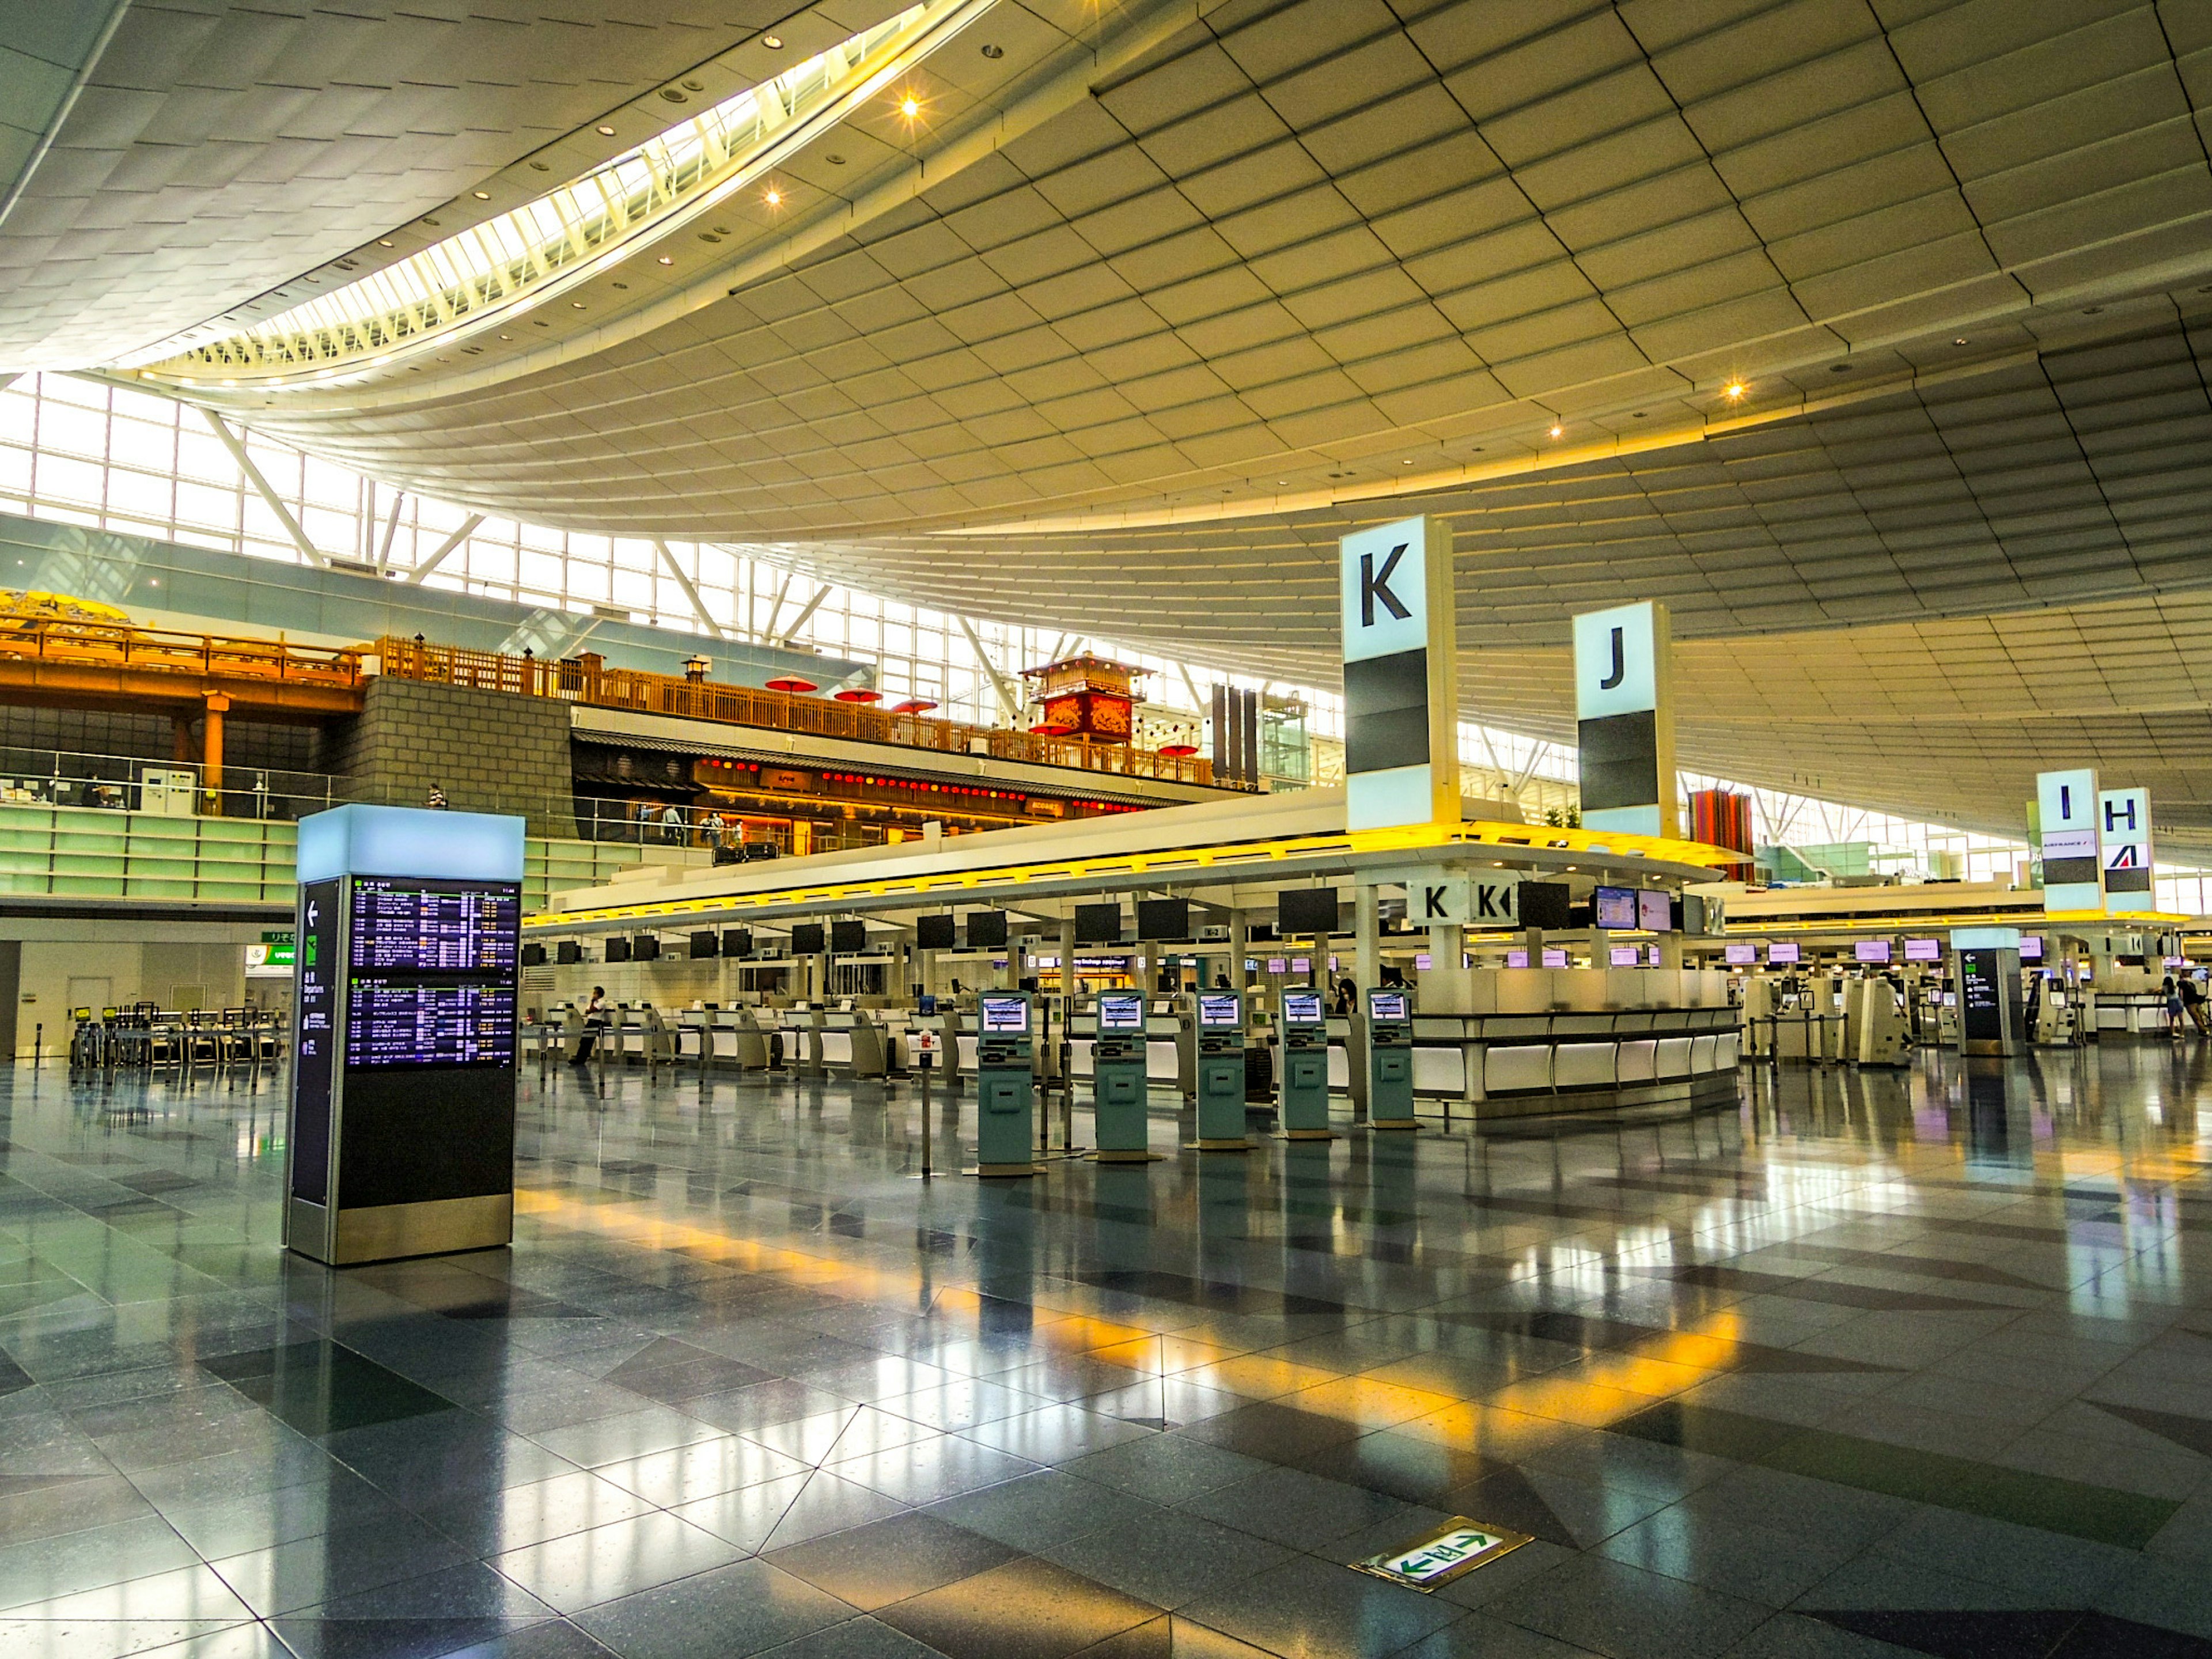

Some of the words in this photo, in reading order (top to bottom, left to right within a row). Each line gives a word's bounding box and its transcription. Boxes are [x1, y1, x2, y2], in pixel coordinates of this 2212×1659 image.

[1360, 543, 1412, 627] K
[1600, 627, 1624, 690] J
[2061, 786, 2071, 819] I
[2105, 799, 2135, 831] H
[1425, 885, 1448, 918] K
[1478, 885, 1498, 917] K
